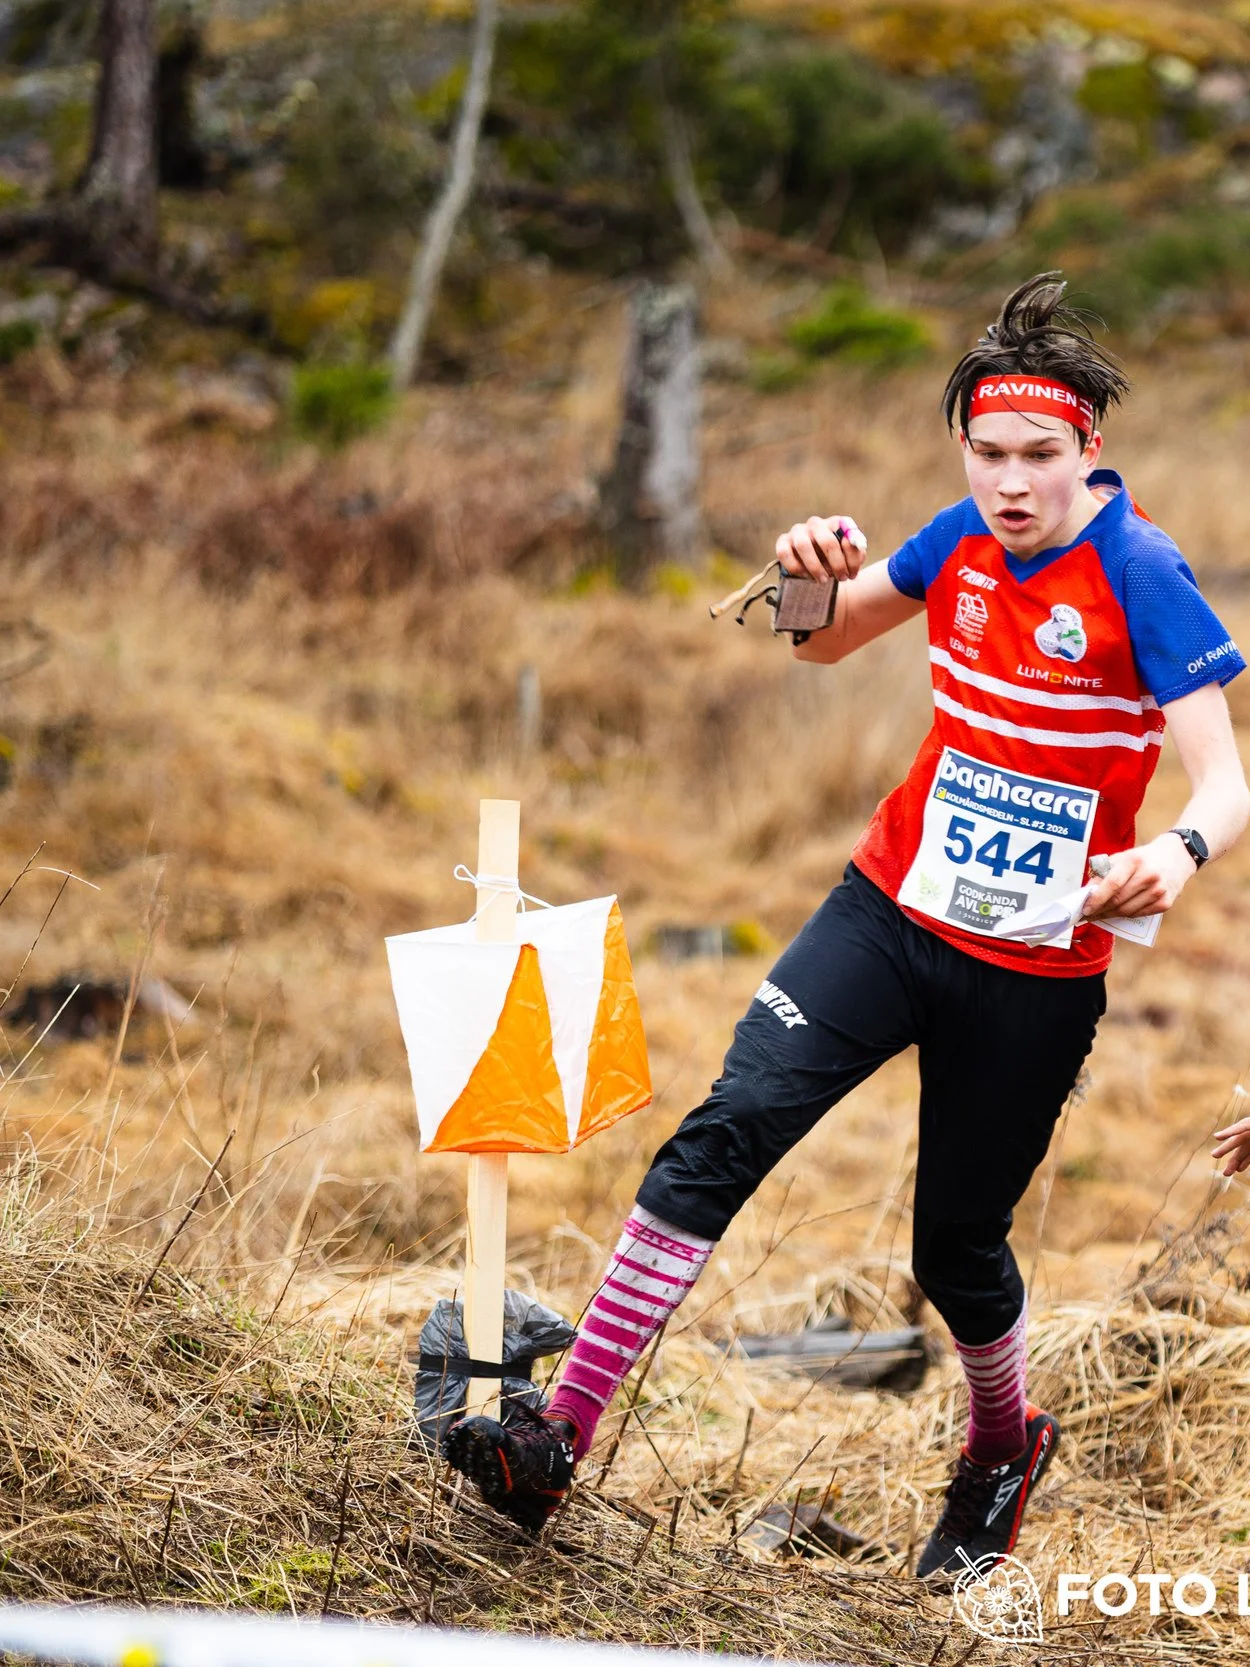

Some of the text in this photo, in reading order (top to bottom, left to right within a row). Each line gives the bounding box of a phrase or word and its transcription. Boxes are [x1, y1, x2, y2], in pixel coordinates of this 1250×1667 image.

[979, 383, 1077, 408] RAVINEN
[1016, 664, 1103, 688] LUMONITE
[1188, 656, 1206, 674] OK
[940, 754, 1091, 821] bagheera
[945, 792, 1014, 823] KOLMÅRDSMEDELN
[1020, 817, 1031, 827] SL
[1031, 820, 1045, 830] #2
[1046, 823, 1069, 836] 2026
[943, 815, 1054, 886] 544
[954, 895, 1016, 918] AVLOPP
[958, 884, 1018, 908] GODKÄNDA
